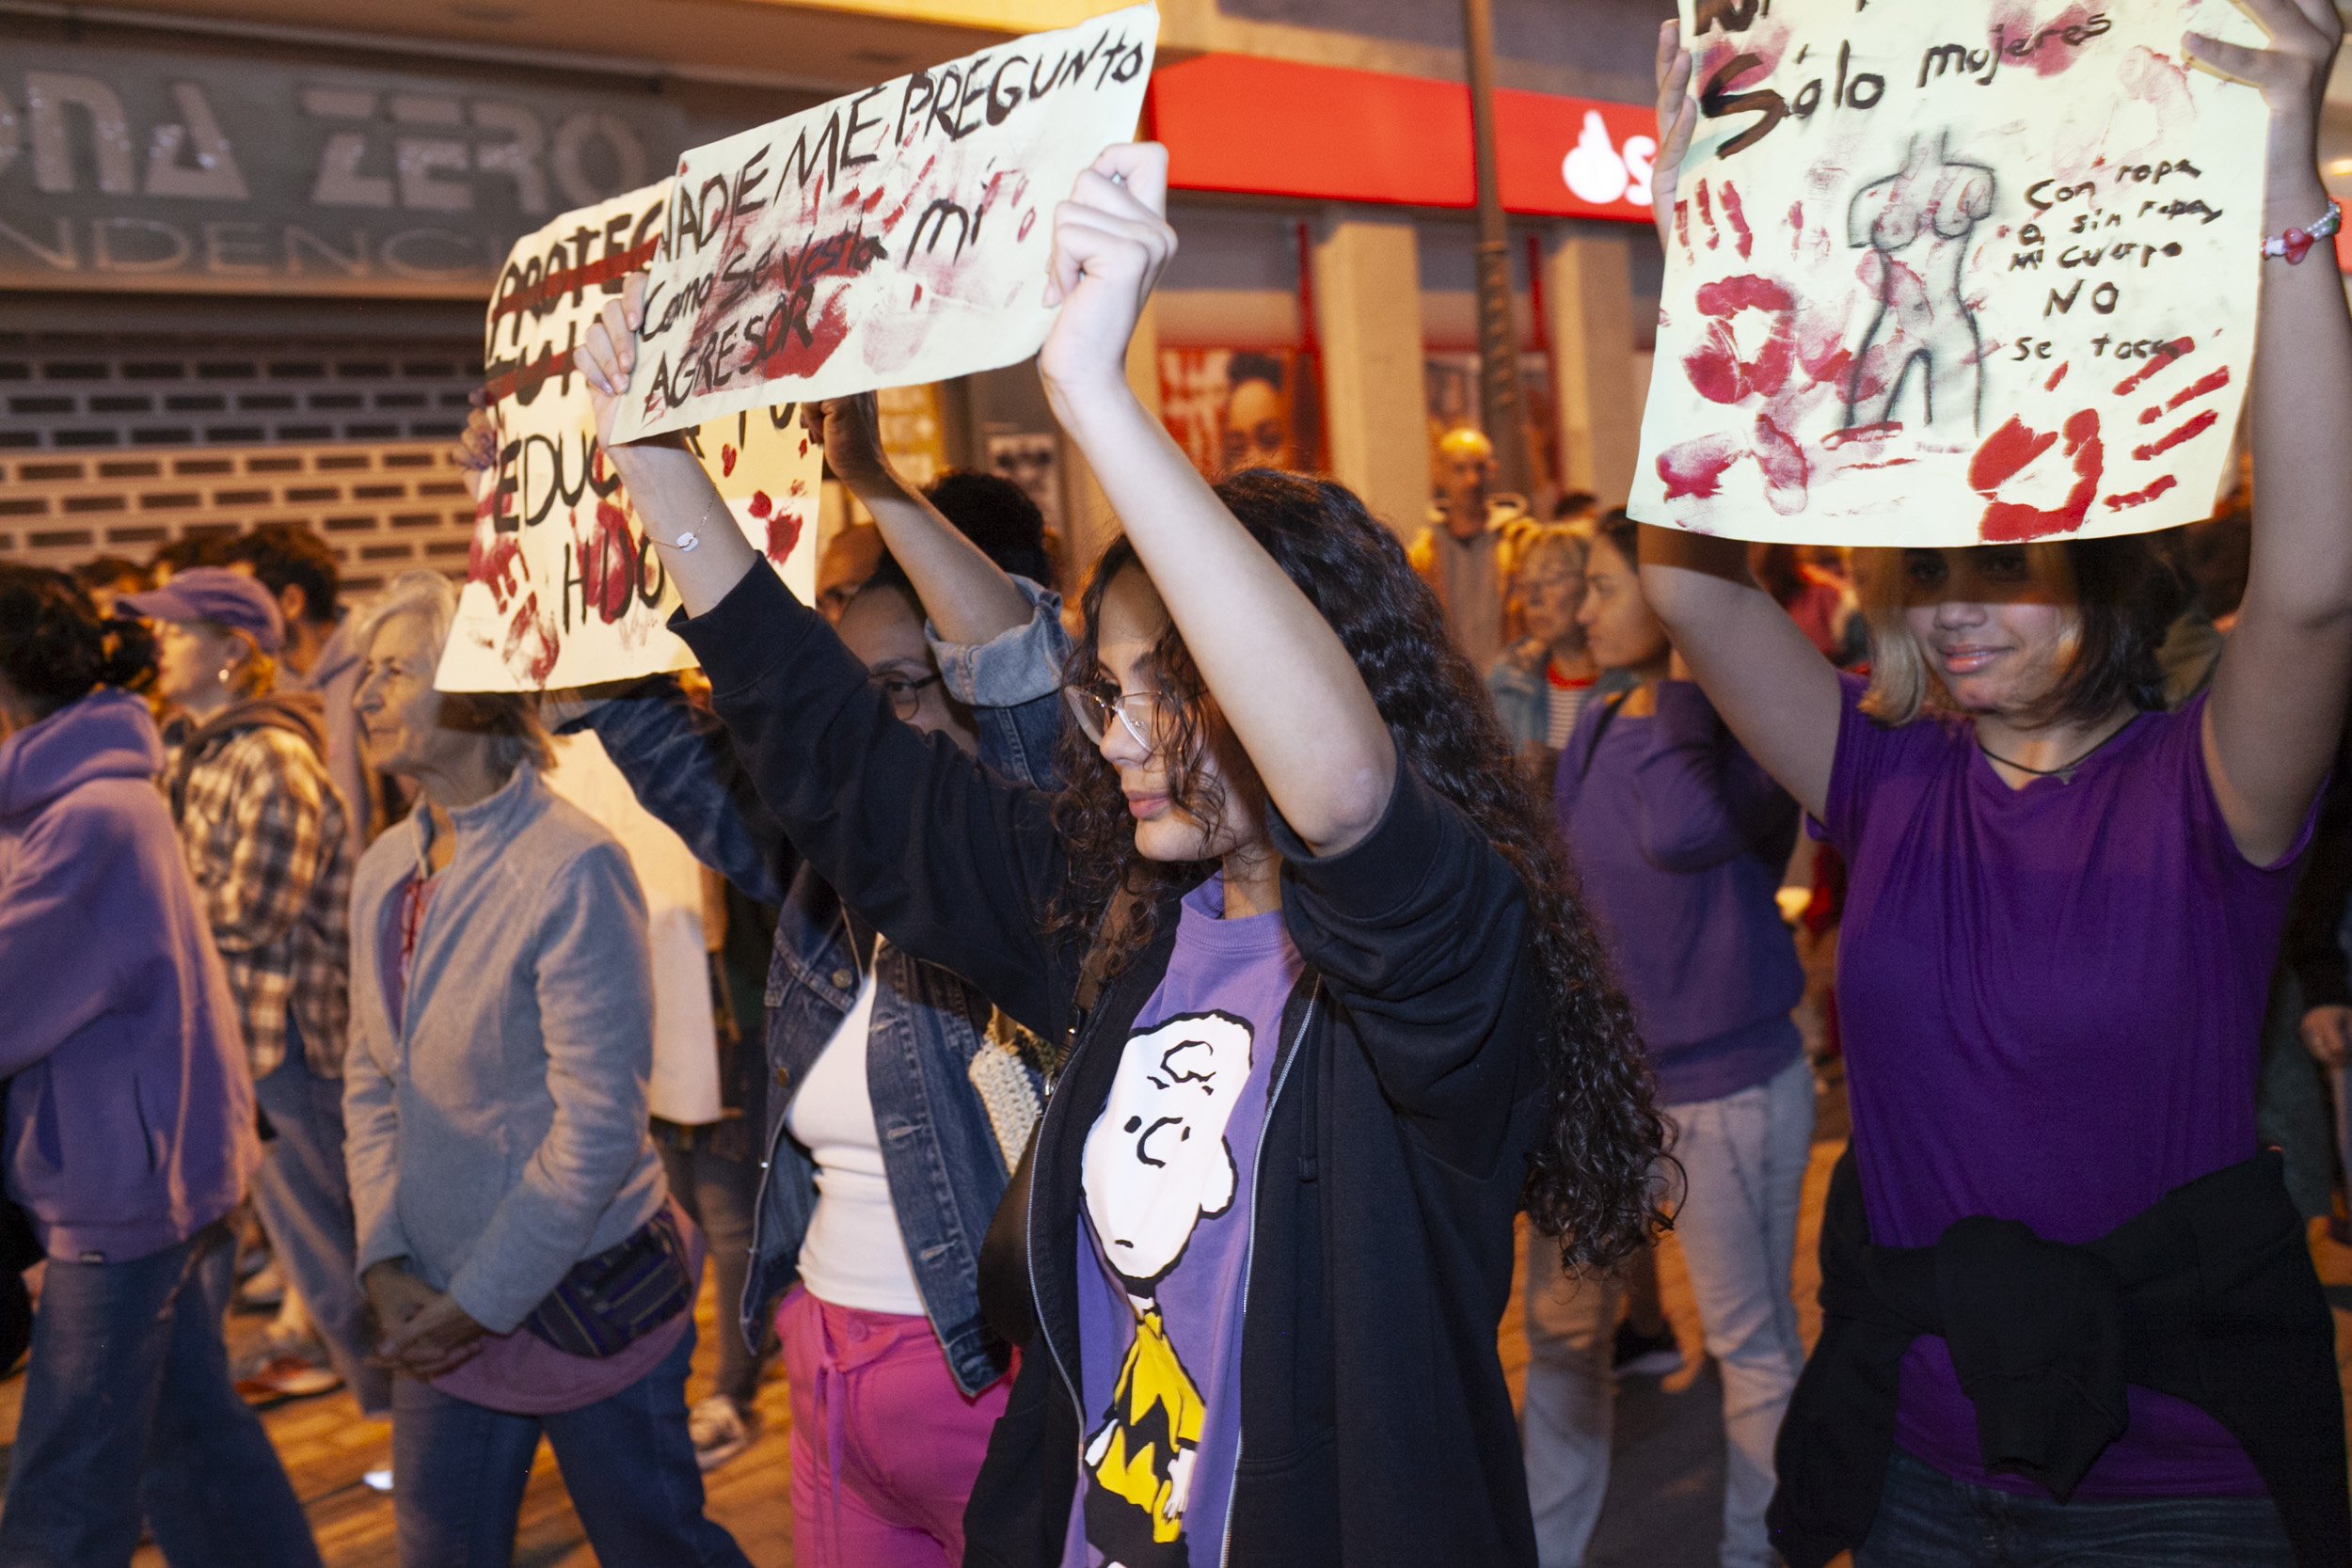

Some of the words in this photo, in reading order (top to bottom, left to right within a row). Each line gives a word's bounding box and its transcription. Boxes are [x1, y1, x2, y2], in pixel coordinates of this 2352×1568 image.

[772, 83, 889, 207] ME
[2115, 158, 2202, 184] ropa
[2069, 208, 2122, 234] sin
[2042, 278, 2120, 321] NO
[641, 282, 816, 423] AGRESOR
